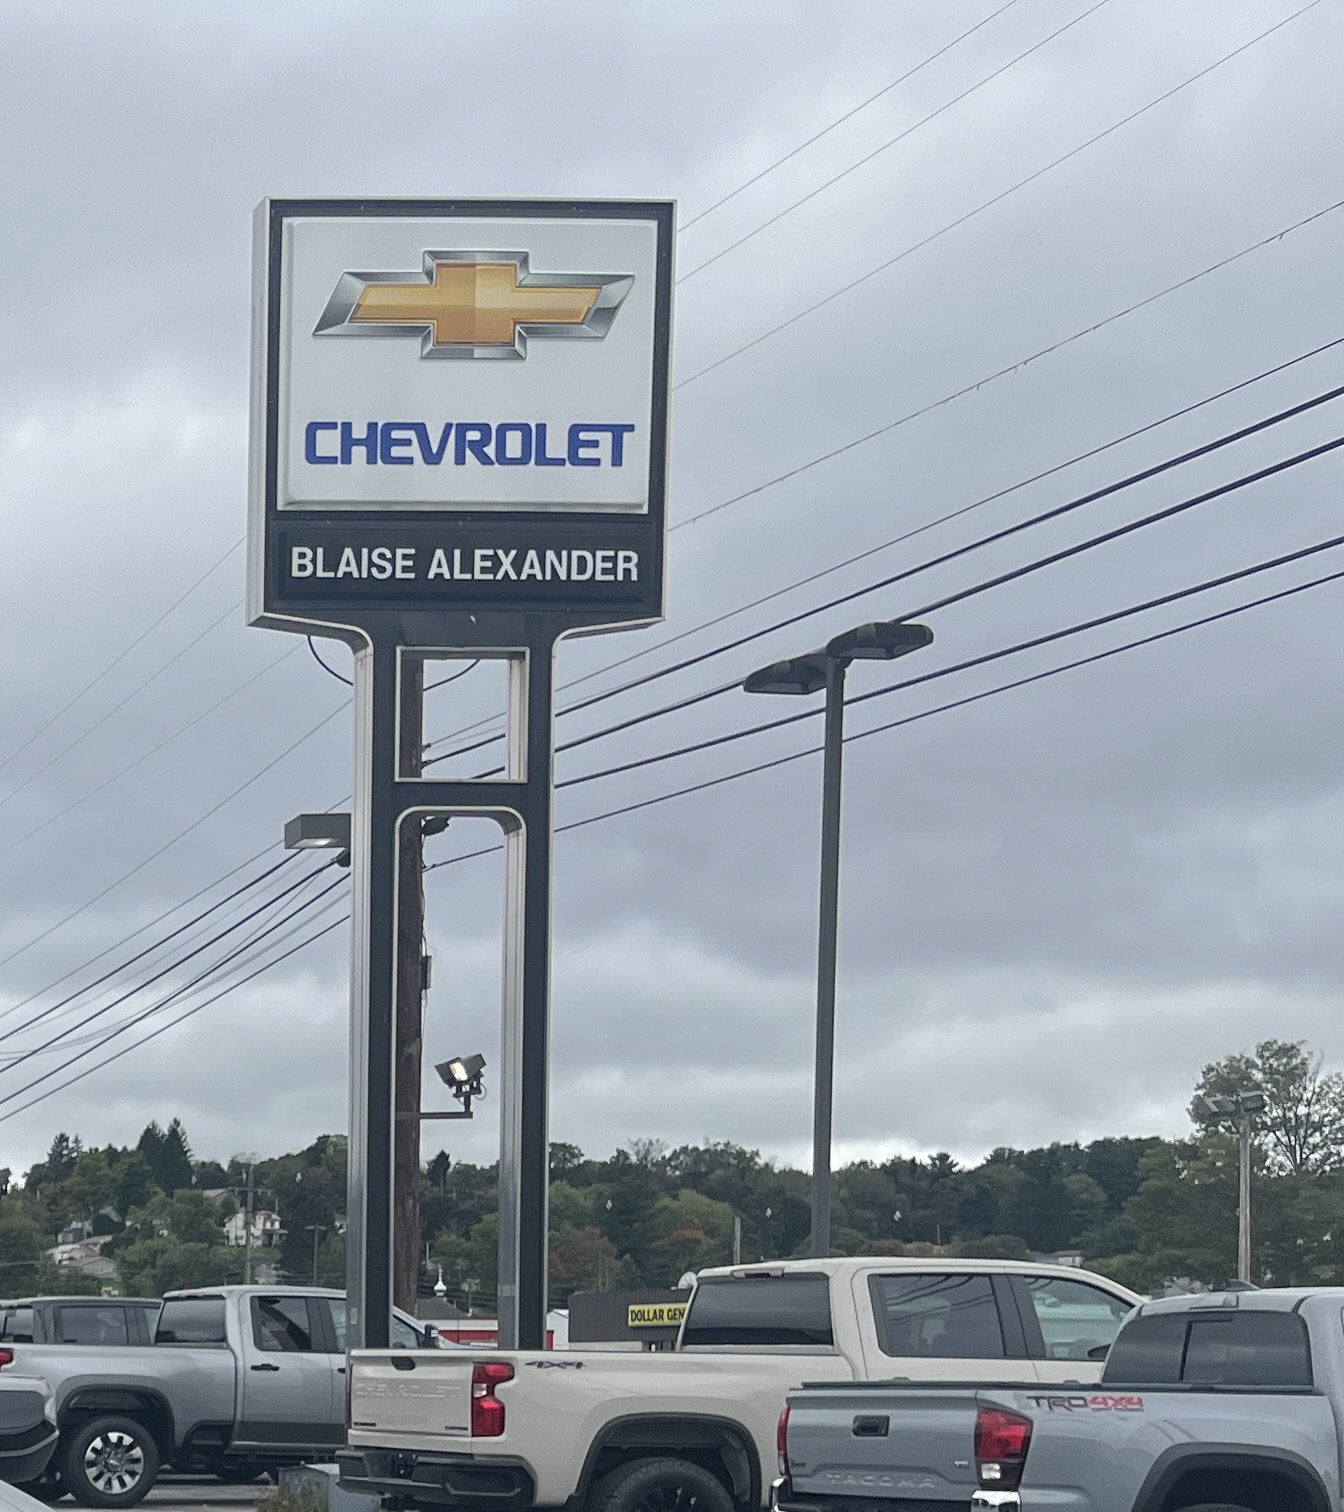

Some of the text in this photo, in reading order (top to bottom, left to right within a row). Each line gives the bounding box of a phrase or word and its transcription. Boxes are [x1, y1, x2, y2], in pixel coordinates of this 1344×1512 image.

[305, 421, 636, 467] CHEVROLET
[291, 546, 639, 582] BLAISE ALEXANDER
[630, 1309, 664, 1322] DOLLAR
[825, 1473, 935, 1489] TACOMA
